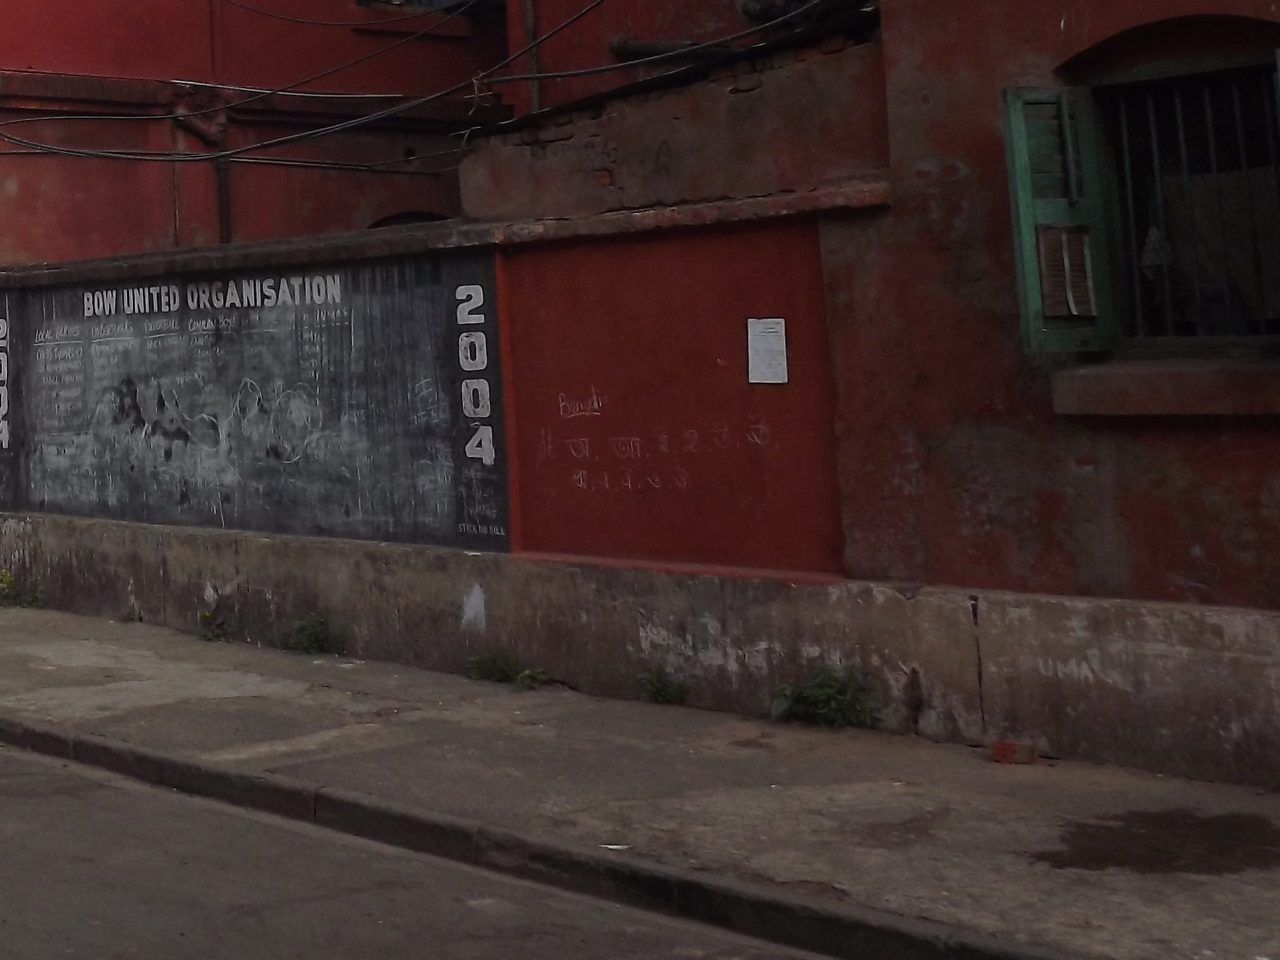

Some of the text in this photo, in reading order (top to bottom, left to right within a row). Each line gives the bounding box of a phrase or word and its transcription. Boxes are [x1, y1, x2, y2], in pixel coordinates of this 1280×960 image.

[83, 274, 342, 317] BOW UNITED ORGANISATION
[455, 284, 496, 466] 2004
